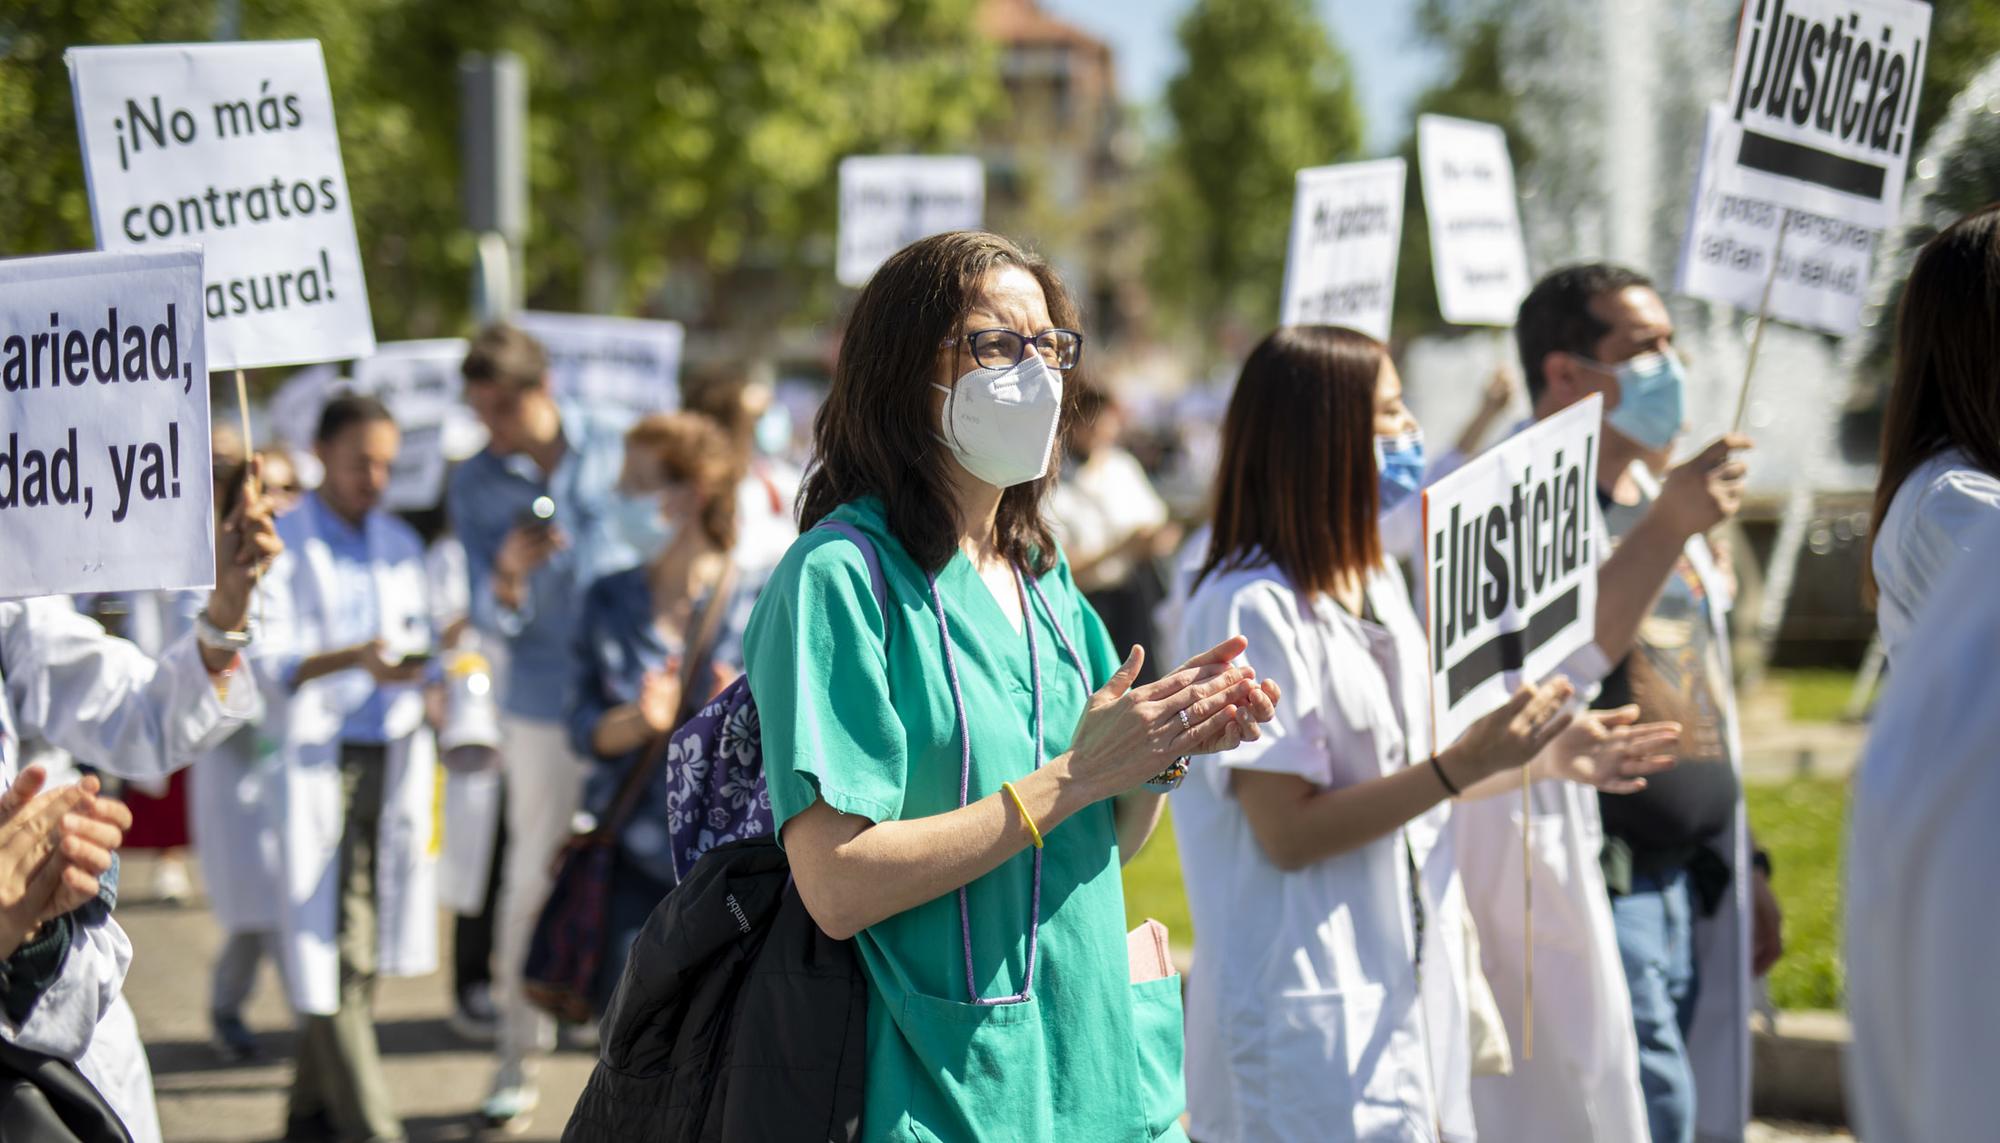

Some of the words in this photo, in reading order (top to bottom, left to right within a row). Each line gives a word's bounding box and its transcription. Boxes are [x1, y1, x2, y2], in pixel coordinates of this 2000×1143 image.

[1734, 0, 1921, 156] ¡Justicia!
[113, 96, 197, 172] ¡No
[213, 79, 303, 139] más
[123, 177, 338, 243] contratos
[205, 248, 336, 320] asura!
[0, 303, 193, 395] ariedad,
[108, 421, 181, 523] ya!
[1434, 434, 1594, 675] ¡Justicia!
